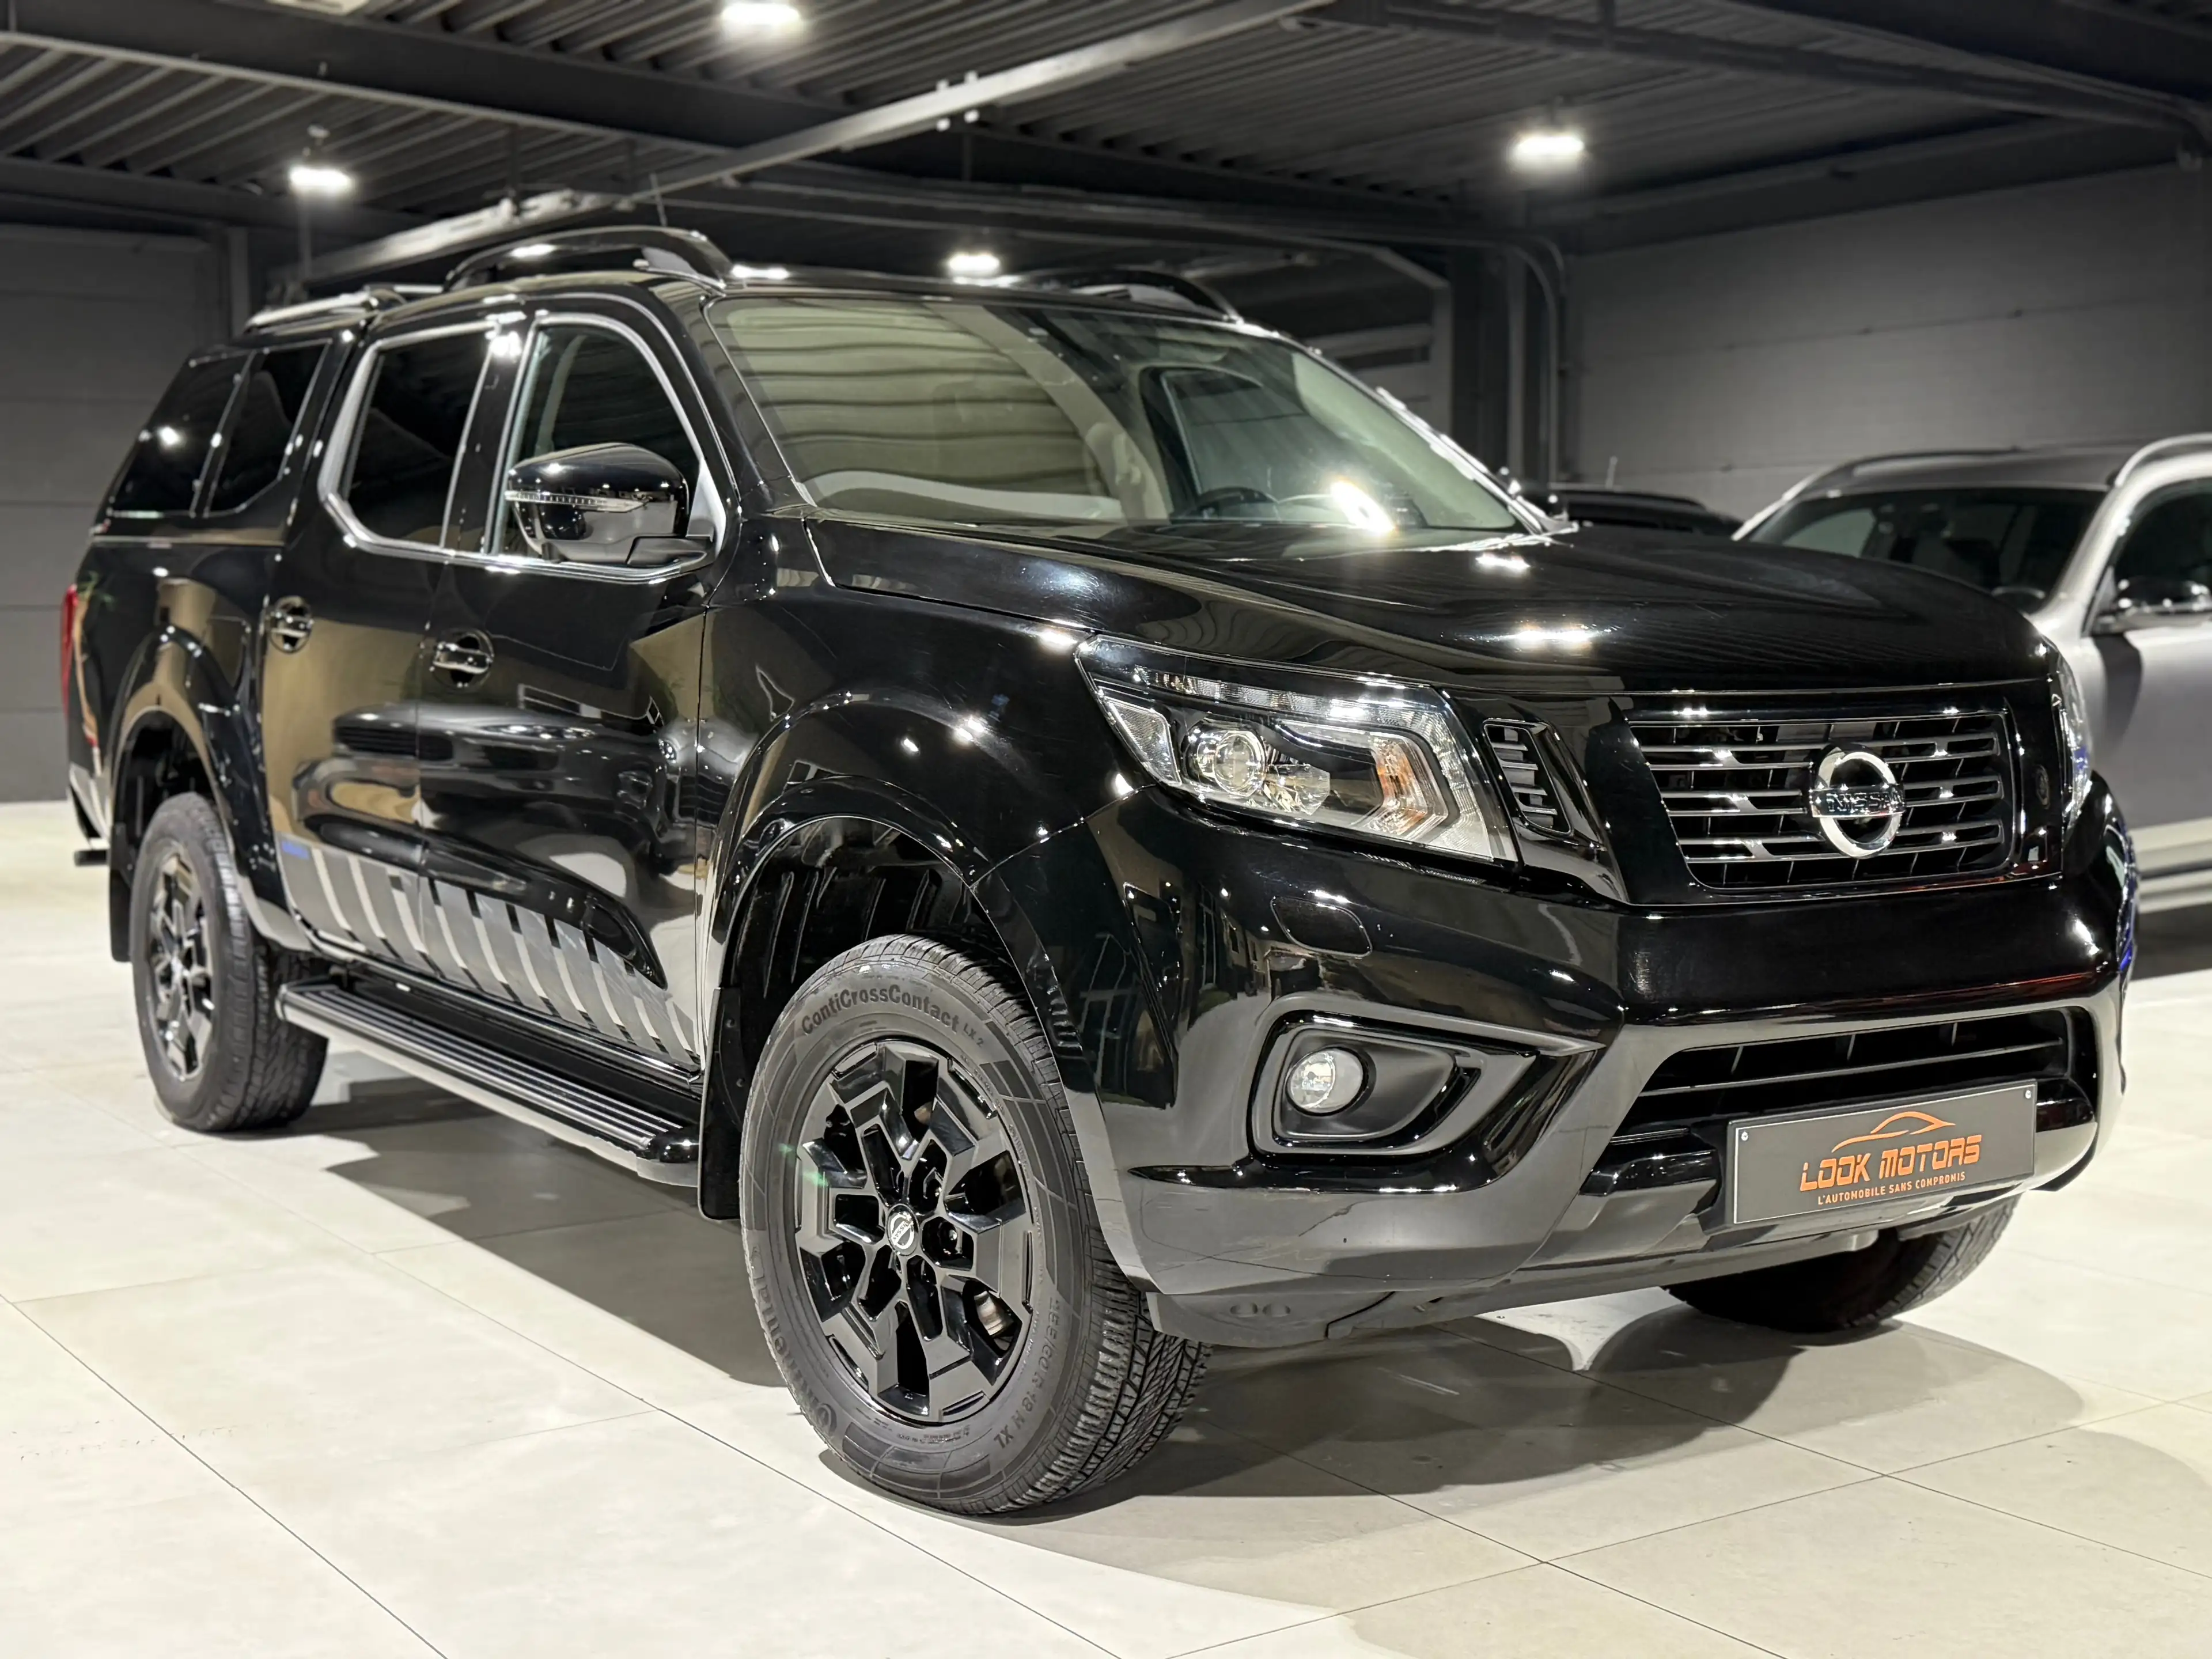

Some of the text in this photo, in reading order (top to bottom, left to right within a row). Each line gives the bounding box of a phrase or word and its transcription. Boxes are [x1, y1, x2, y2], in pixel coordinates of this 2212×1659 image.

[801, 984, 984, 1048] ContiCrossContact LX 2
[1800, 1134, 1982, 1191] LOOK MOTORS
[1817, 1171, 1966, 1205] L'AUTOMOBILE SANS COMPROMIS
[994, 1425, 1014, 1449] XL
